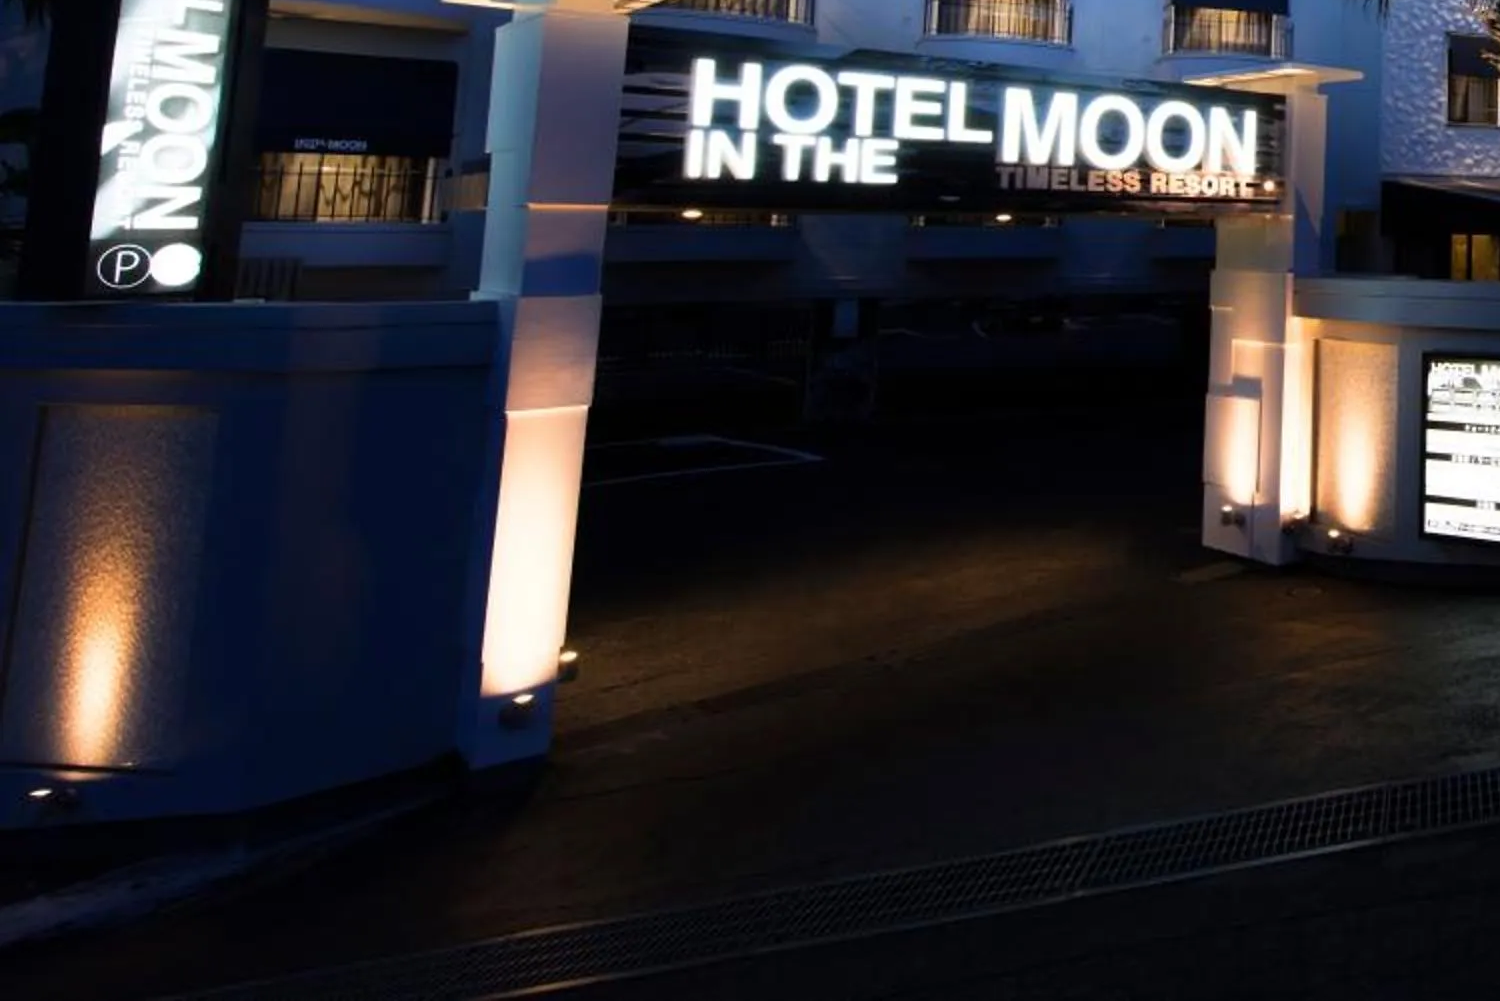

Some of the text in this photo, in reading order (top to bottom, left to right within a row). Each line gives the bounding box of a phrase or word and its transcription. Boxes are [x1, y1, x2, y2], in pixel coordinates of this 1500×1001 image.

[131, 27, 220, 230] MOON
[690, 57, 1258, 176] HOTEL MOON
[684, 129, 899, 185] IN THE
[996, 165, 1256, 198] TIMELESS RESORT
[114, 249, 141, 284] P
